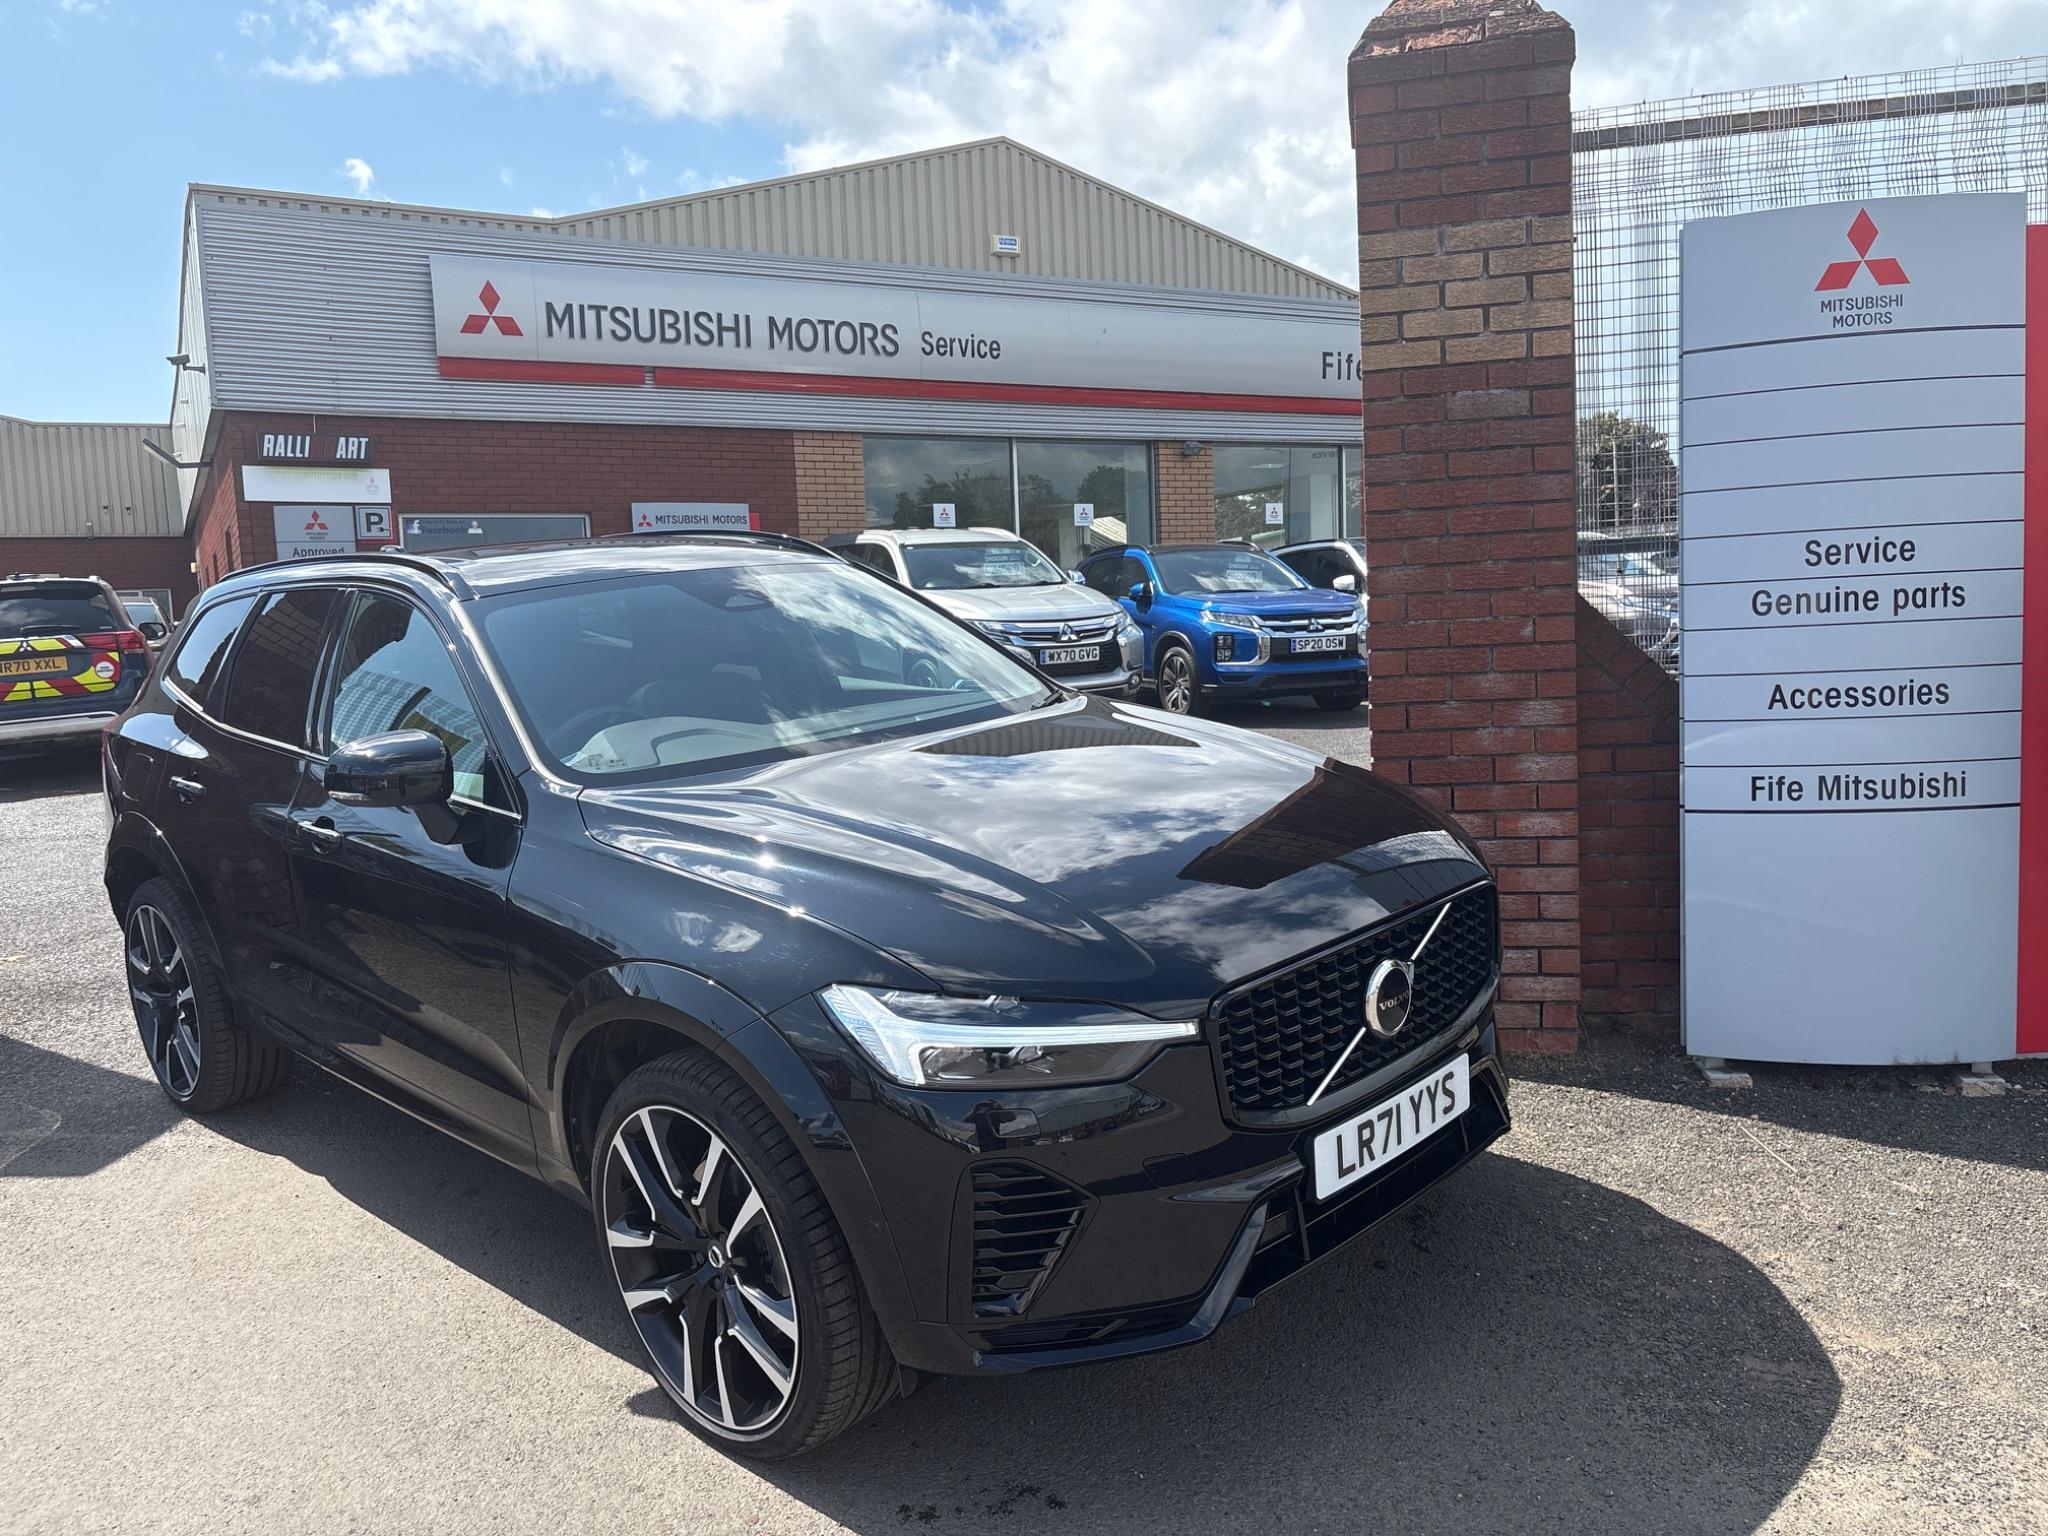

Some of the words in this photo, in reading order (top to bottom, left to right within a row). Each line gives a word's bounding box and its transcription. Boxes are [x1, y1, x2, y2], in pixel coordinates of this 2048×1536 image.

[1820, 293, 1904, 313] MITSUBISHI
[545, 301, 752, 348] MITSUBISHI
[768, 315, 899, 358] MOTORS
[921, 330, 1001, 360] Service
[1832, 311, 1893, 329] MOTORS
[263, 434, 310, 457] RALLI
[336, 437, 369, 459] ART
[365, 512, 384, 533] P
[422, 525, 467, 534] Facebook
[655, 514, 709, 525] MITSUBISHI
[712, 514, 748, 525] MOTORS
[1804, 536, 1916, 567] Service
[1751, 586, 1880, 617] Genuine
[1893, 582, 1966, 617] parts
[1298, 638, 1323, 650] SP20
[33, 659, 62, 671] XXL
[1767, 679, 1950, 710] Accessories
[1750, 775, 1804, 802] Fife
[1817, 770, 1967, 801] Mitsubishi
[1378, 990, 1410, 1010] VOLVO
[1336, 1102, 1402, 1180] LR71
[1408, 1071, 1456, 1135] YYS
